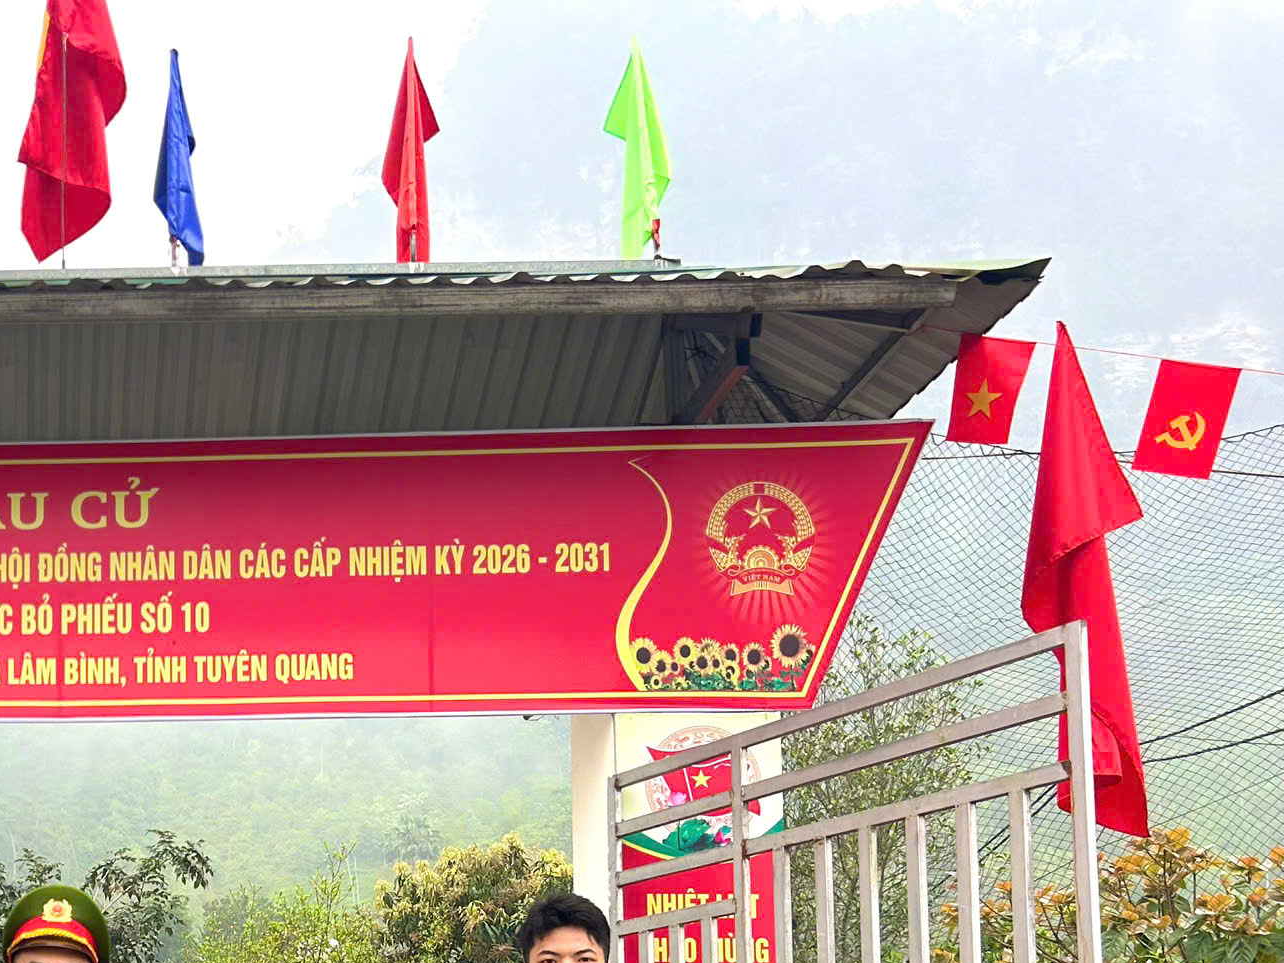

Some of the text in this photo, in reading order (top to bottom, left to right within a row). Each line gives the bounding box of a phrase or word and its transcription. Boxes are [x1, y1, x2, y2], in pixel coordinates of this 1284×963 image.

[70, 477, 160, 531] CỬ
[35, 542, 102, 583] ĐỒNG
[109, 544, 176, 582] NHÂN
[182, 543, 232, 581] DÂN
[239, 542, 287, 580] CÁC
[293, 536, 342, 578] CẤP
[348, 539, 428, 583] NHIỆM
[434, 538, 465, 576] KỲ
[472, 543, 531, 575] 2026
[537, 556, 548, 564] -
[554, 542, 610, 573] 2031
[20, 592, 54, 636] BỎ
[60, 592, 133, 636] PHIẾU
[139, 590, 173, 635] SỐ
[180, 601, 211, 634] 10
[7, 651, 57, 686] LÂM
[63, 650, 127, 688] BÌNH,
[132, 647, 187, 684] TỈNH
[193, 648, 268, 684] TUYÊN
[274, 652, 354, 685] QUANG
